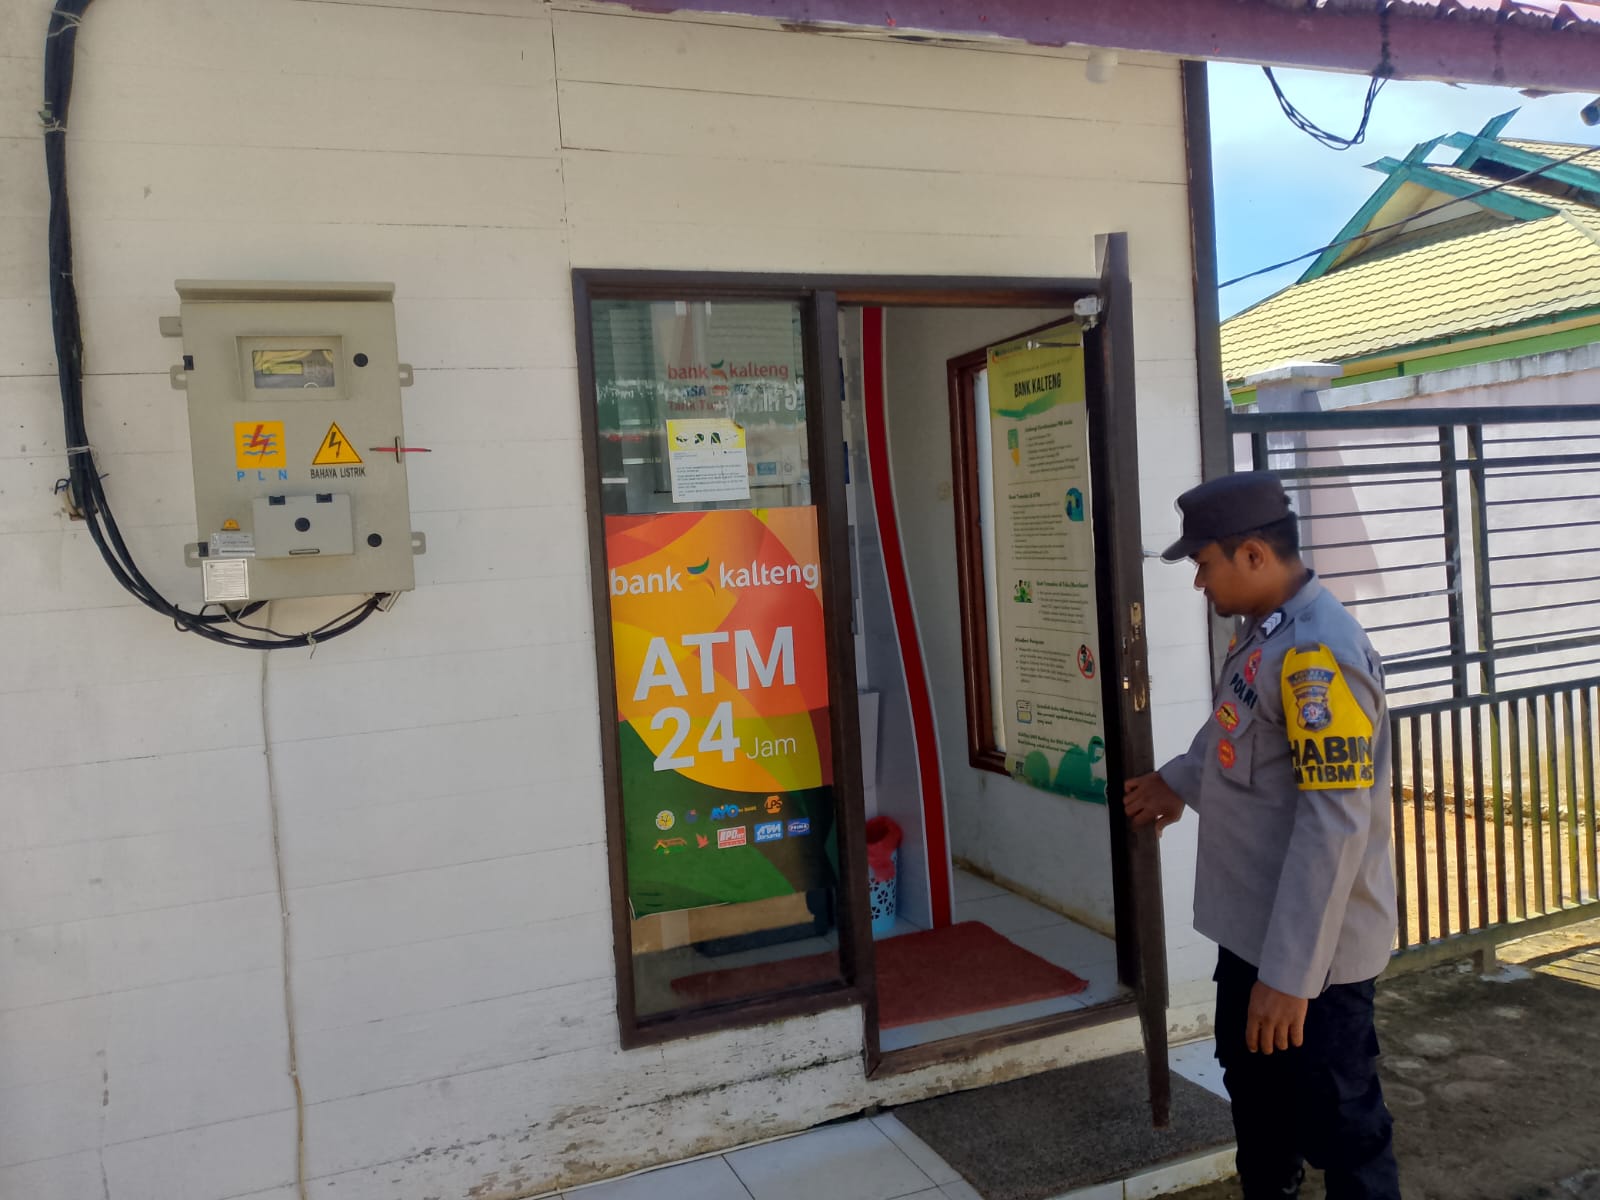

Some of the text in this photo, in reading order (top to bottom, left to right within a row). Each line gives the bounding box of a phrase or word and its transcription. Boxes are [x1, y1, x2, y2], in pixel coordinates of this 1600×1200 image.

[667, 362, 789, 380] bank kalteng
[1014, 372, 1062, 398] BANK KALTENG
[310, 467, 366, 480] BAHAYA LISTRIK
[610, 560, 819, 596] bank kalteng
[632, 626, 796, 702] ATM
[1229, 672, 1259, 710] POLRI
[650, 701, 797, 772] 24 Jam
